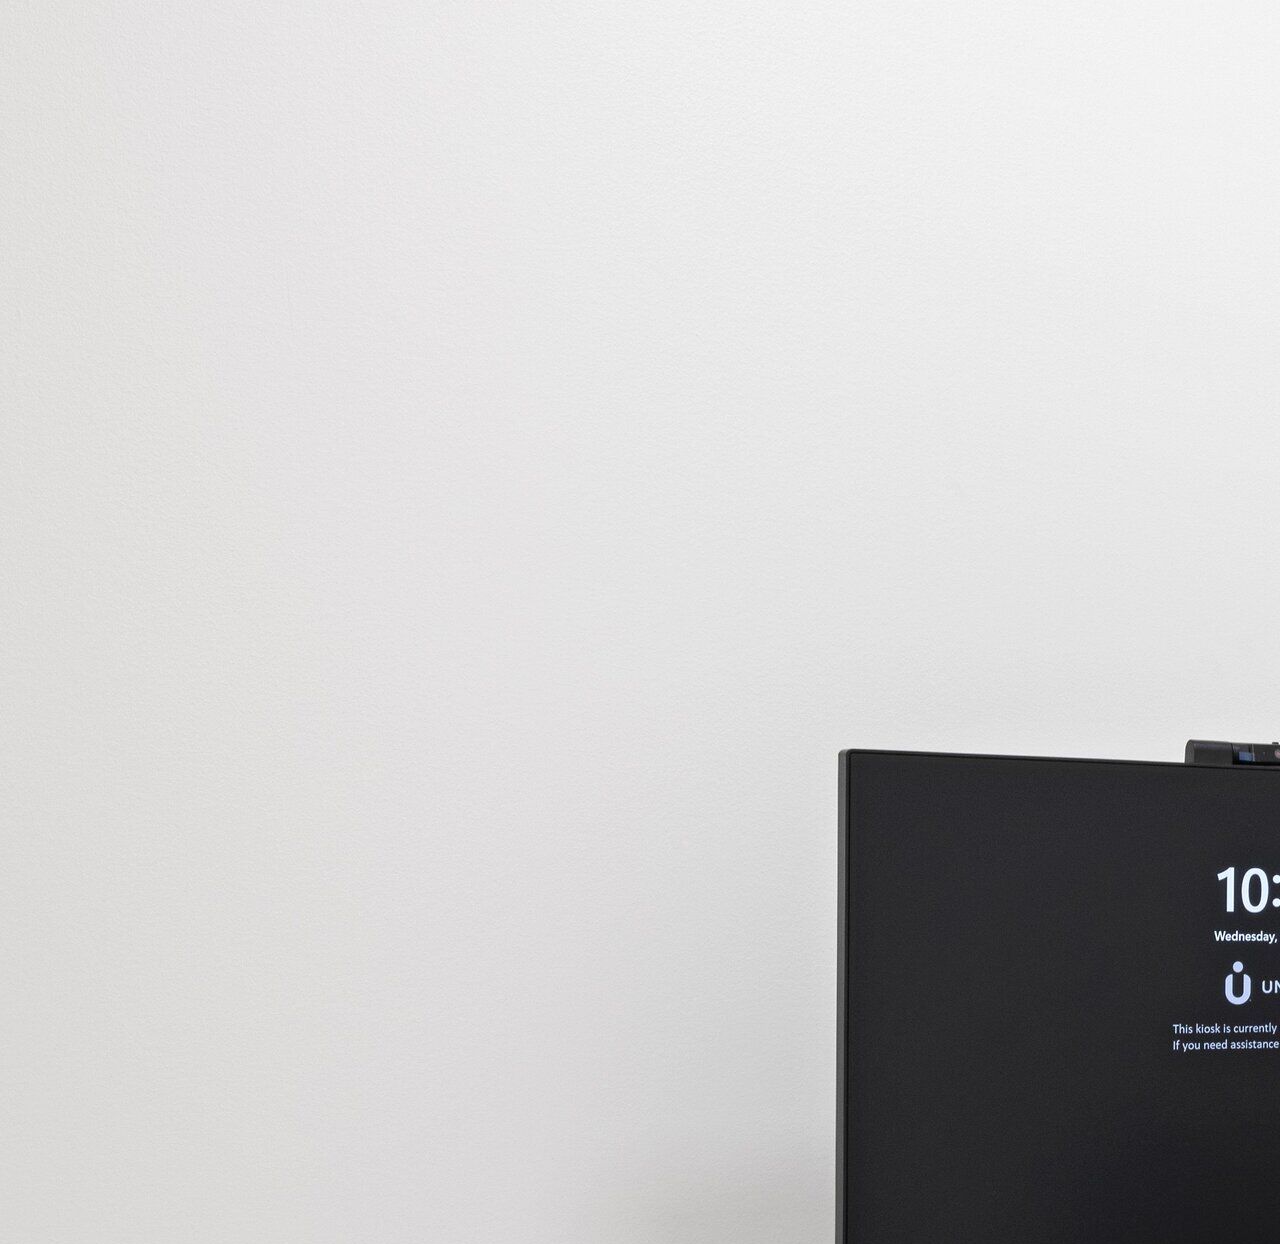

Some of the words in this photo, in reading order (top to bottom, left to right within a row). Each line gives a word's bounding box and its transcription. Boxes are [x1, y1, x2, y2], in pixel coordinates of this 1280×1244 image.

[1214, 930, 1278, 944] Wednesday,
[1172, 1023, 1193, 1034] This
[1195, 1022, 1221, 1034] kiosk
[1223, 1023, 1231, 1034] is
[1233, 1022, 1277, 1035] currently
[1172, 1040, 1180, 1051] If
[1182, 1041, 1201, 1052] you
[1203, 1039, 1228, 1050] need
[1230, 1039, 1279, 1050] assistance
